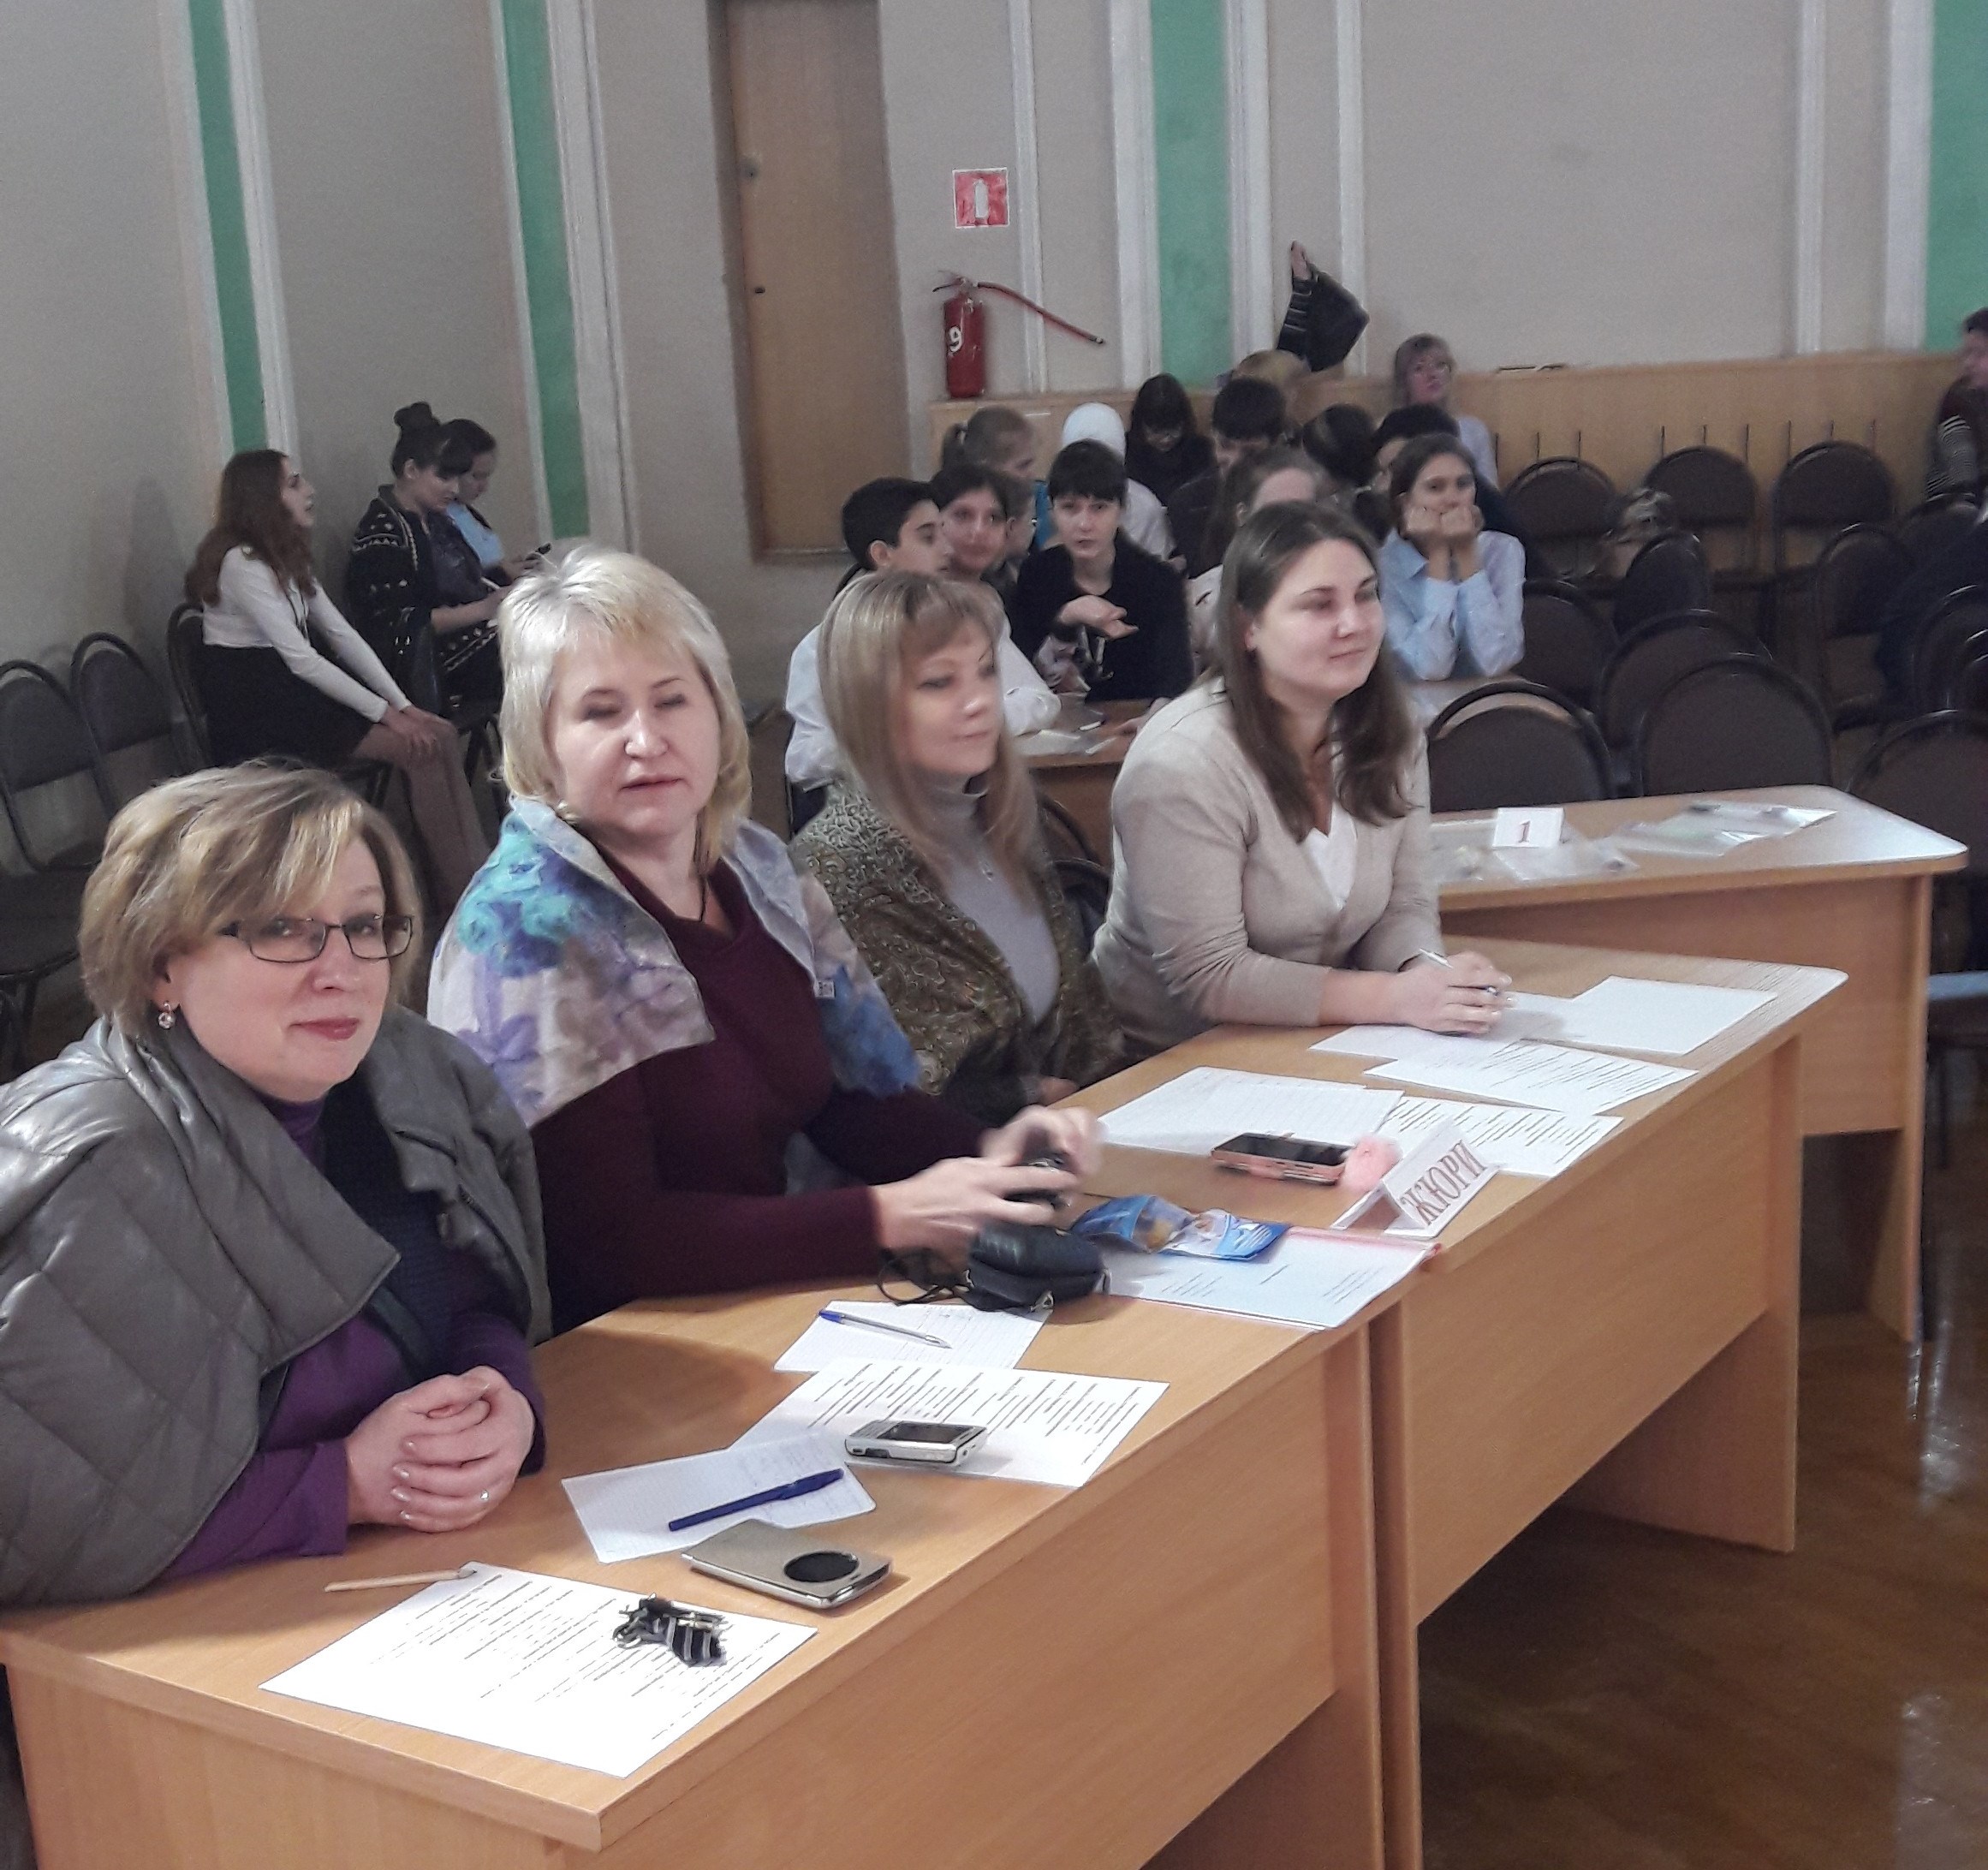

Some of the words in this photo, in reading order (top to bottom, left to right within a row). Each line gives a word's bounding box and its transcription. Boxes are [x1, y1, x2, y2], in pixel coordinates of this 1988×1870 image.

[949, 326, 962, 352] 9
[1518, 820, 1531, 843] 1
[1399, 1140, 1486, 1225] ЖЮРИ
